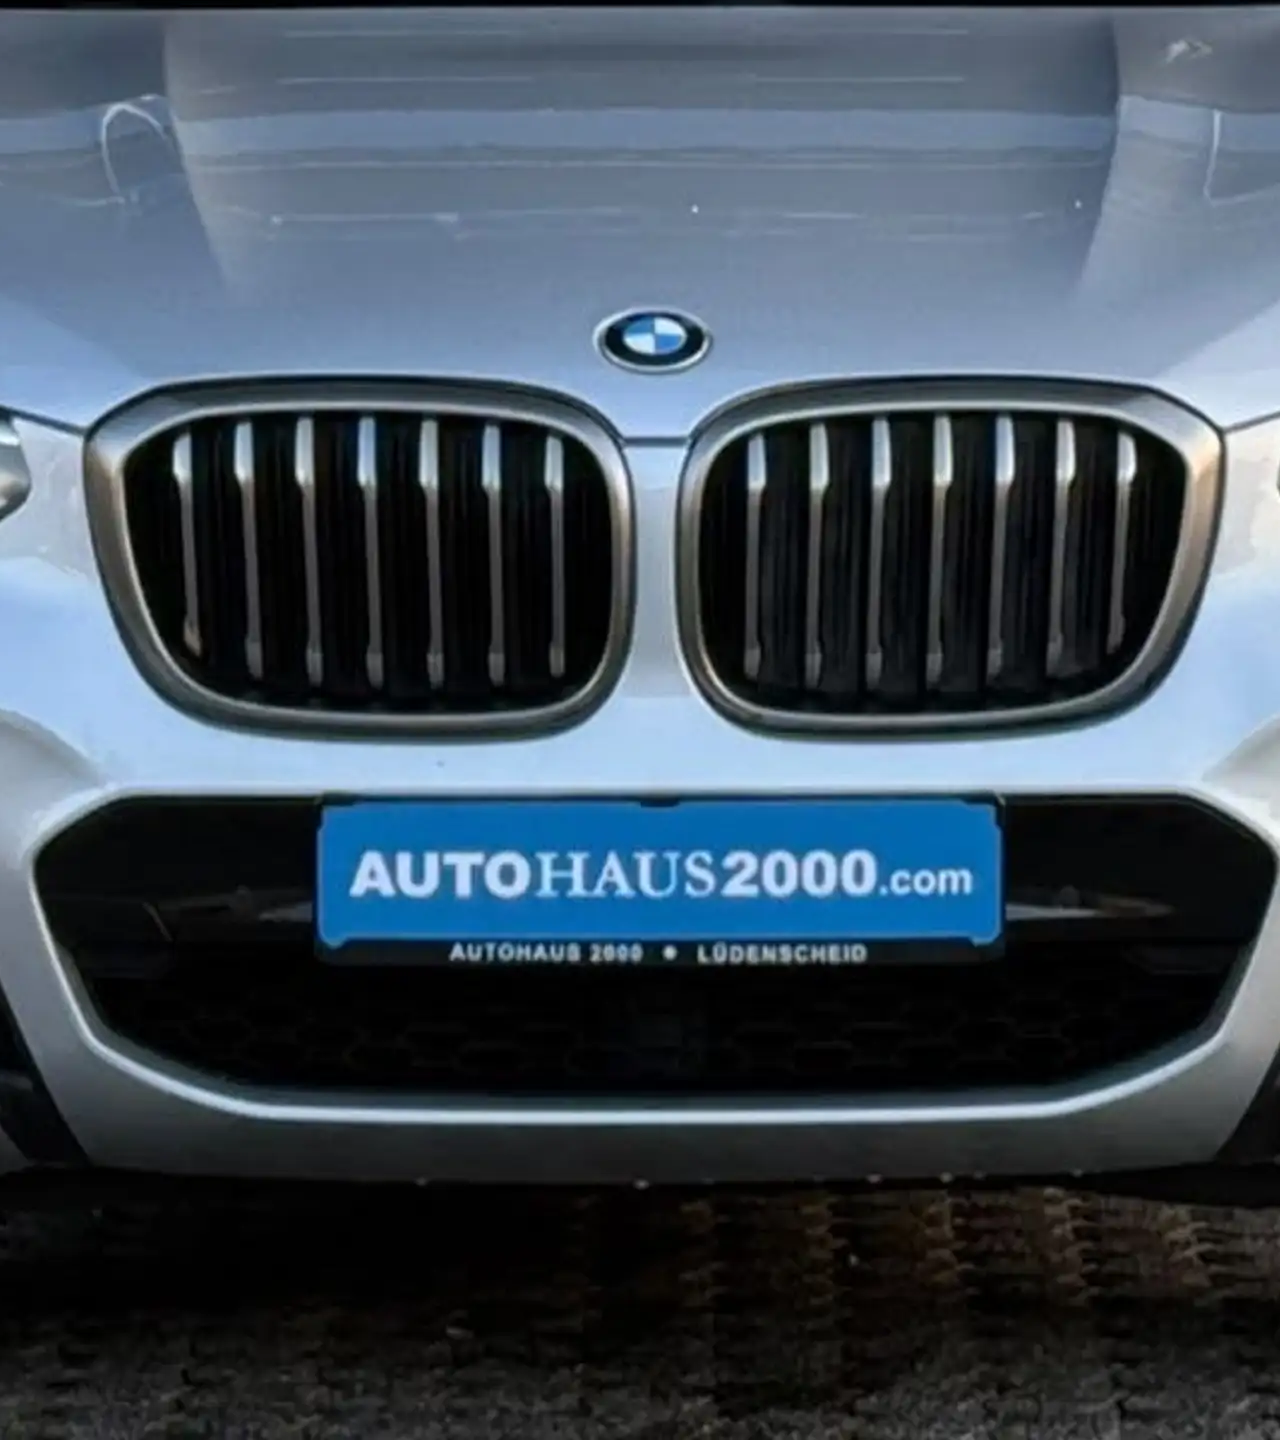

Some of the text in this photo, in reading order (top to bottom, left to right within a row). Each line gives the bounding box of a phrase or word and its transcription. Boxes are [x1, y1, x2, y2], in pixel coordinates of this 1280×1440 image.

[347, 849, 973, 898] AUTOHAUS2000.com
[449, 940, 867, 964] AUTOHAUS 2000 LÜDENSCHEID
